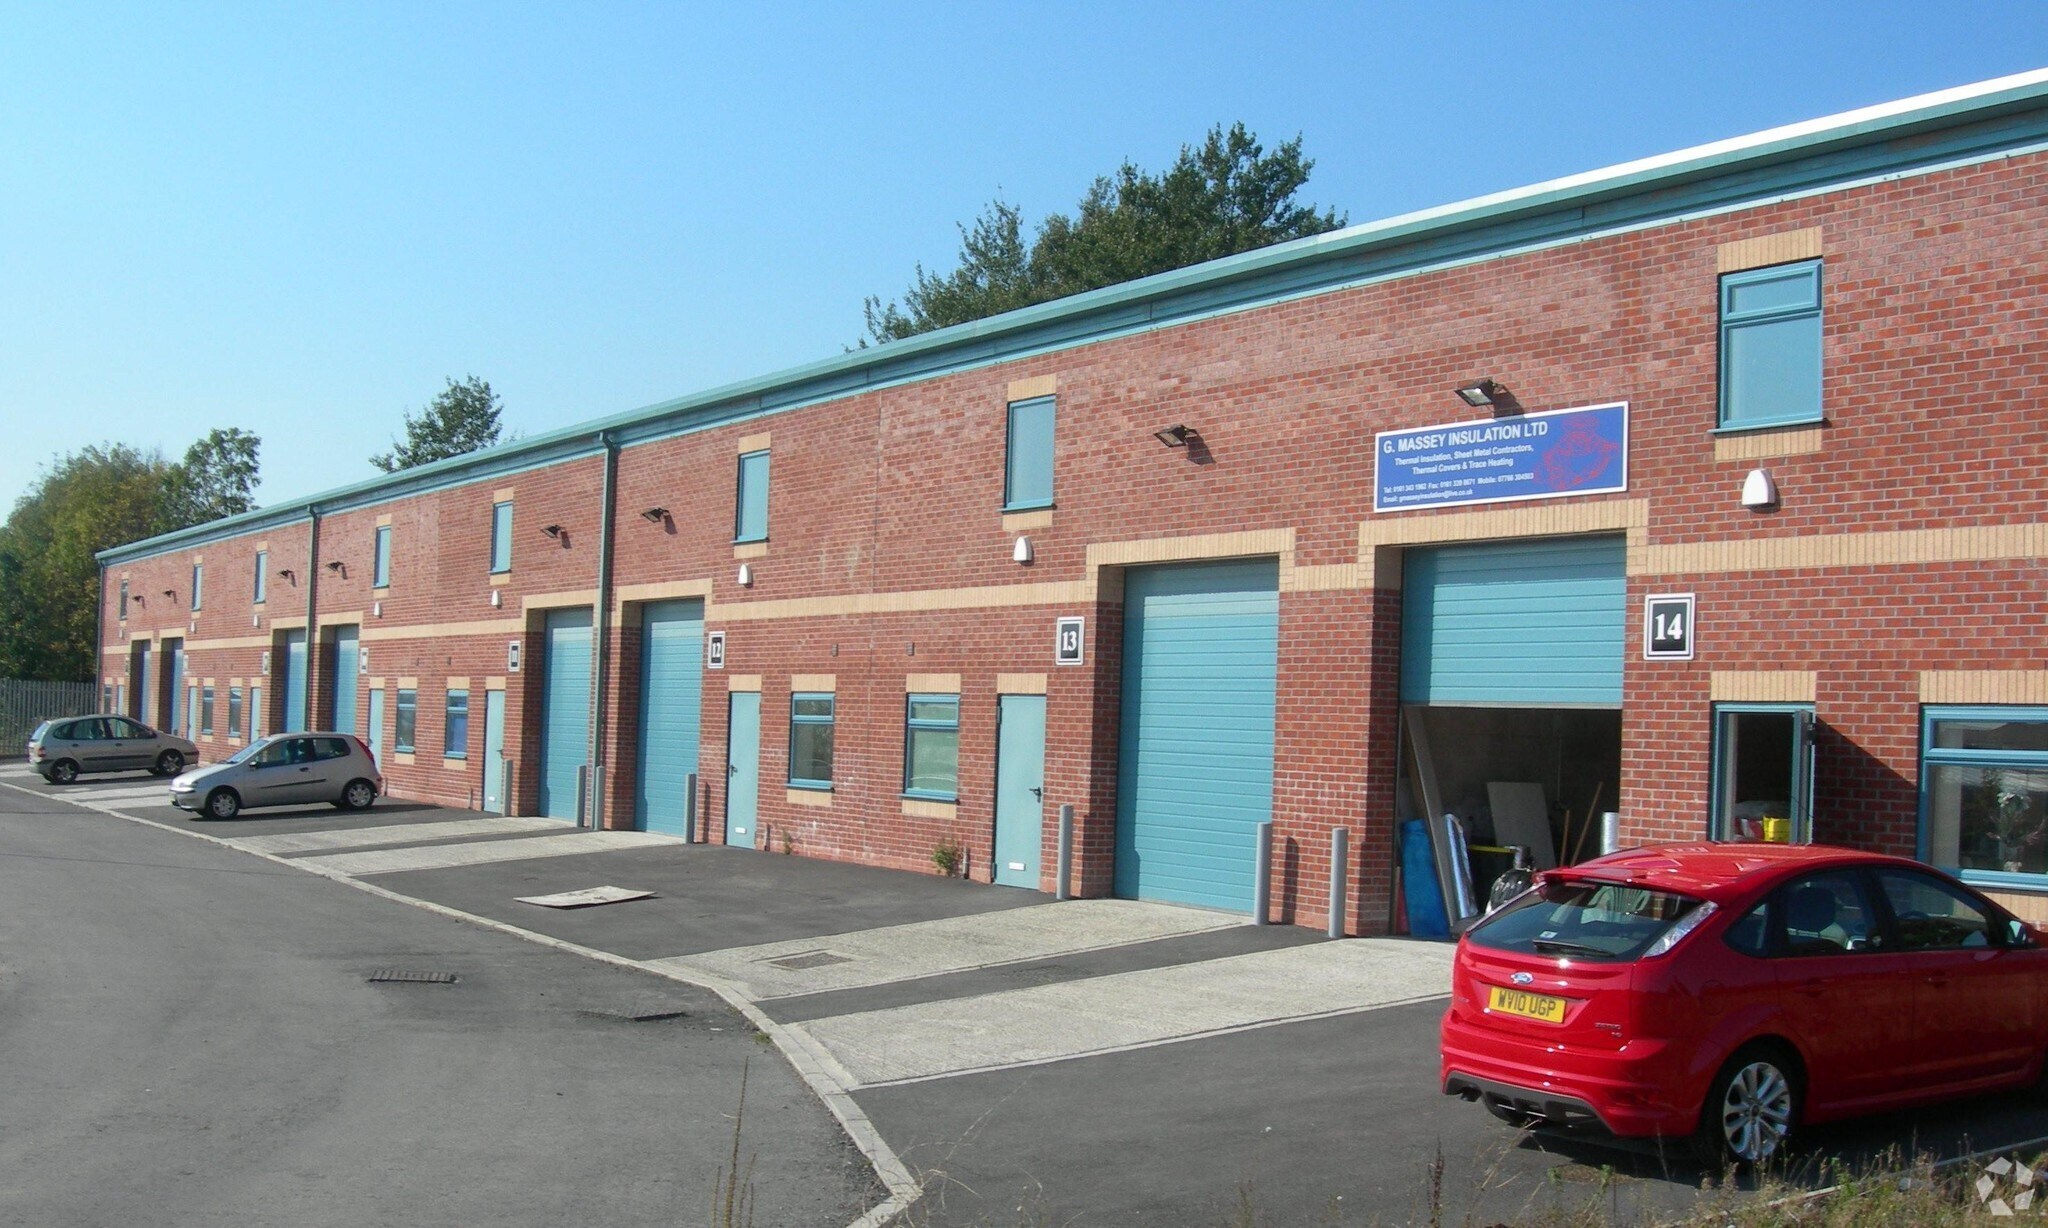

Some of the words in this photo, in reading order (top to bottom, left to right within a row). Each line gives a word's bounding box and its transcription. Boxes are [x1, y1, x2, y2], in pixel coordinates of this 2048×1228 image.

[1383, 440, 1395, 453] G.
[1398, 433, 1446, 452] MASSEY
[1448, 424, 1520, 446] INSULATION
[1524, 421, 1548, 437] LTD
[1395, 456, 1419, 466] Thermal
[1421, 453, 1453, 463] Insulation,
[1454, 450, 1473, 460] Sheet
[1474, 447, 1491, 457] Metal
[1492, 444, 1534, 455] Contractors,
[1412, 465, 1437, 475] Thermal
[1438, 463, 1460, 473] Covers
[1462, 461, 1468, 470] &
[1469, 459, 1487, 469] Trace
[1488, 457, 1513, 467] Heating
[1655, 612, 1683, 640] 14
[712, 642, 721, 658] 12
[1062, 630, 1077, 651] 13
[1529, 996, 1556, 1017] UGP
